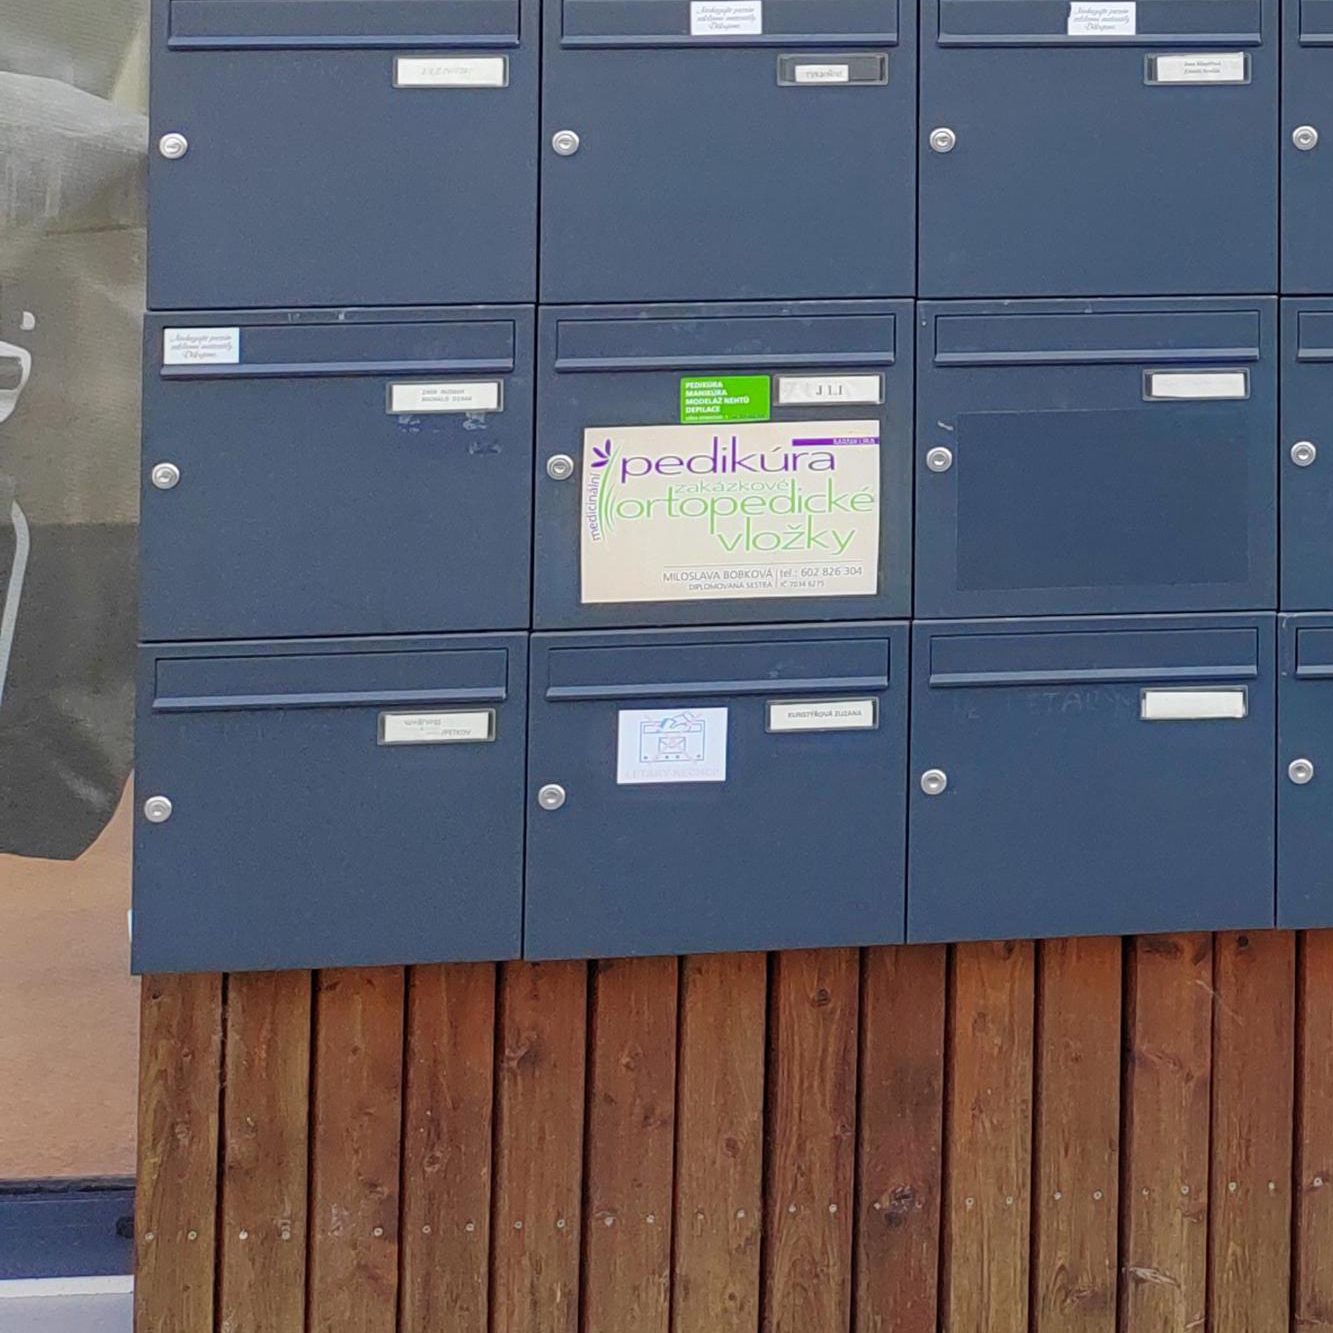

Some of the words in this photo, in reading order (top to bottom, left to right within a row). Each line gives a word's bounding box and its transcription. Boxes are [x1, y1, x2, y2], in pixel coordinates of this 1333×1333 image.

[621, 436, 836, 483] pedikúra
[616, 477, 875, 535] ortopedické
[674, 478, 790, 495] zakázkové
[717, 515, 855, 555] vložky
[663, 570, 721, 582] MILOSLAVA
